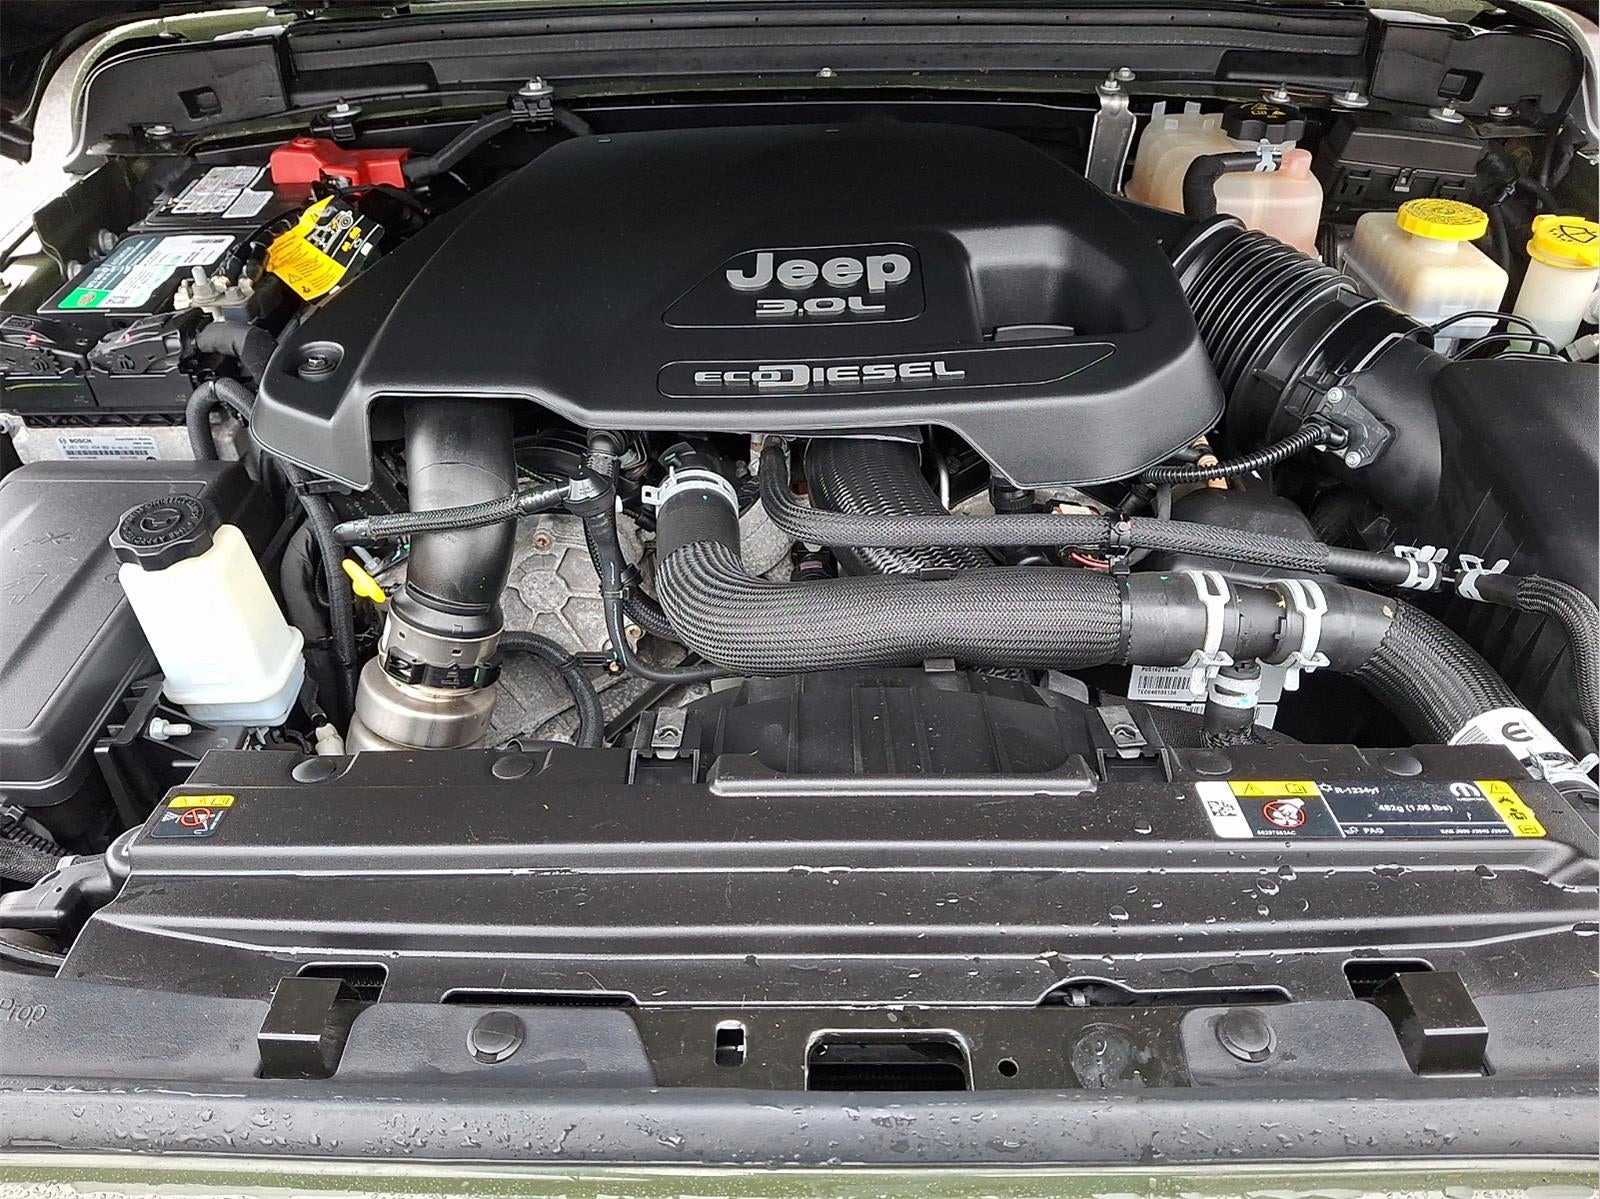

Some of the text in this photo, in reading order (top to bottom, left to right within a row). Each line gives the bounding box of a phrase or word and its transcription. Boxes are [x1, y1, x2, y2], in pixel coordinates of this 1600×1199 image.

[726, 252, 912, 293] Jeep
[755, 296, 887, 318] 3.0L
[693, 361, 966, 391] ECODIESEL
